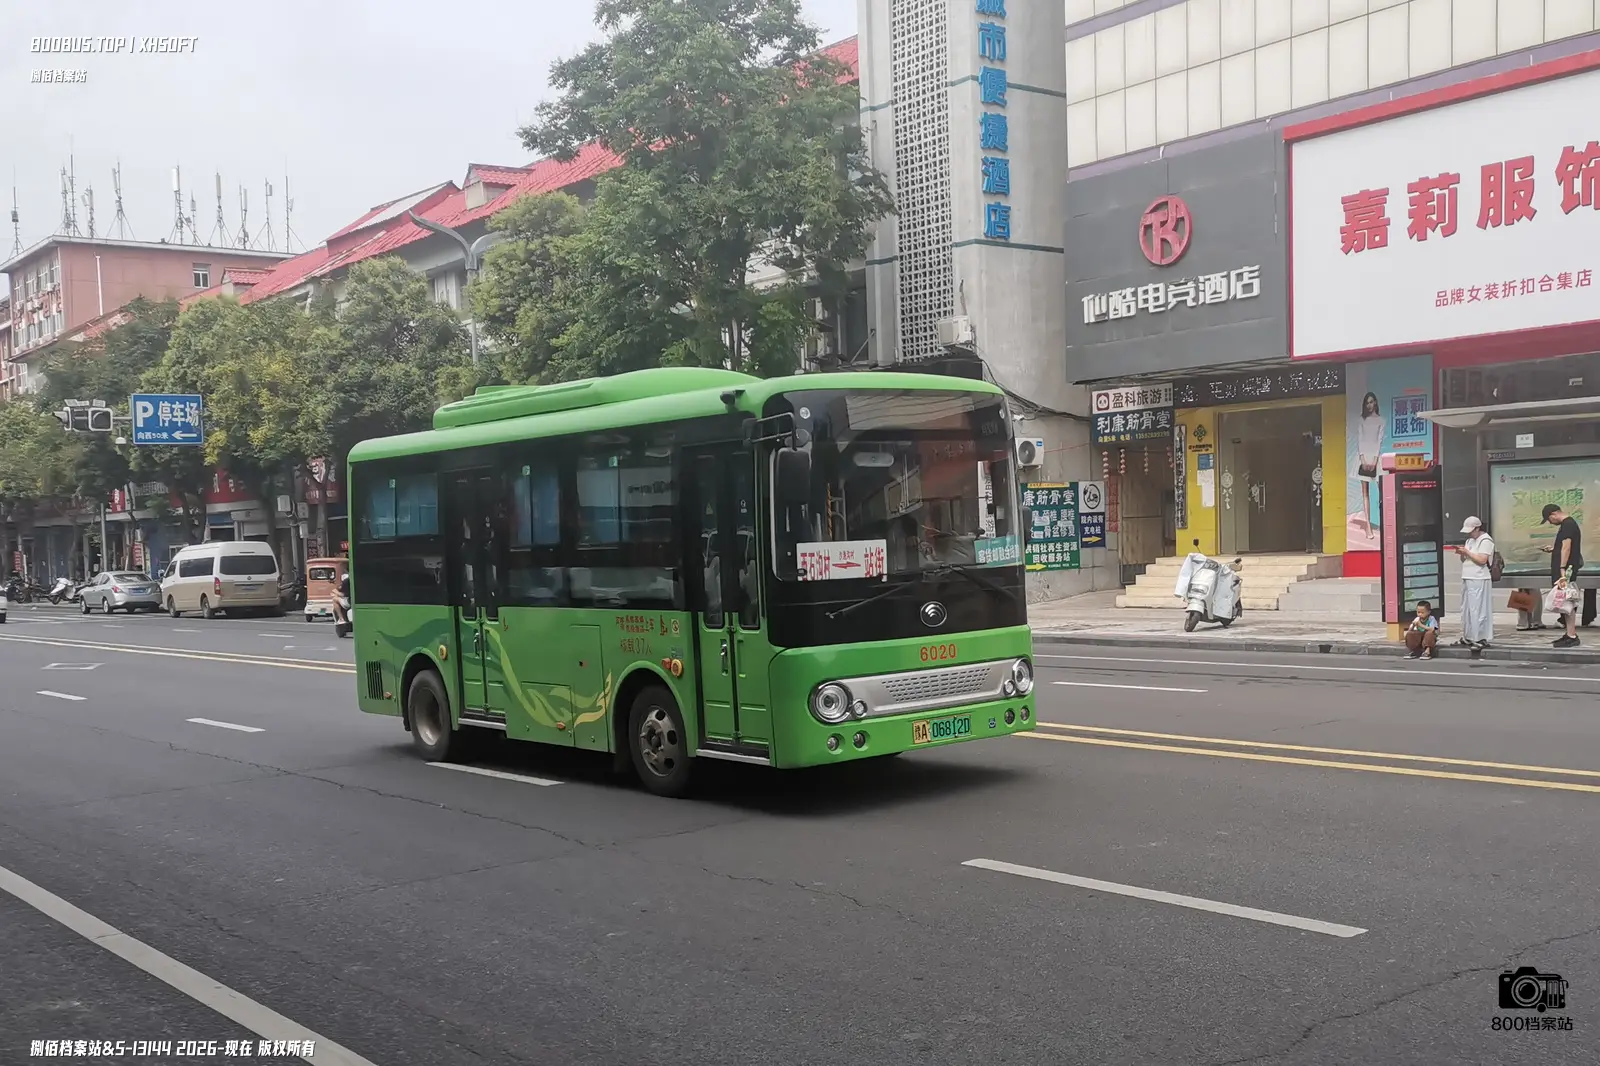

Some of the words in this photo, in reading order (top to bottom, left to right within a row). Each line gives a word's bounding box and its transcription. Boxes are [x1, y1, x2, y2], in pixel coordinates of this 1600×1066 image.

[1340, 141, 1600, 255] 嘉莉服饰
[1435, 269, 1593, 308] 品牌女装折扣合集店
[1112, 388, 1162, 409] 盈科旅游
[136, 401, 154, 427] P
[158, 401, 199, 427] 停车场
[1096, 410, 1171, 434] 利康筋骨堂
[1032, 552, 1071, 563] 回收服务站
[920, 643, 957, 661] 6020
